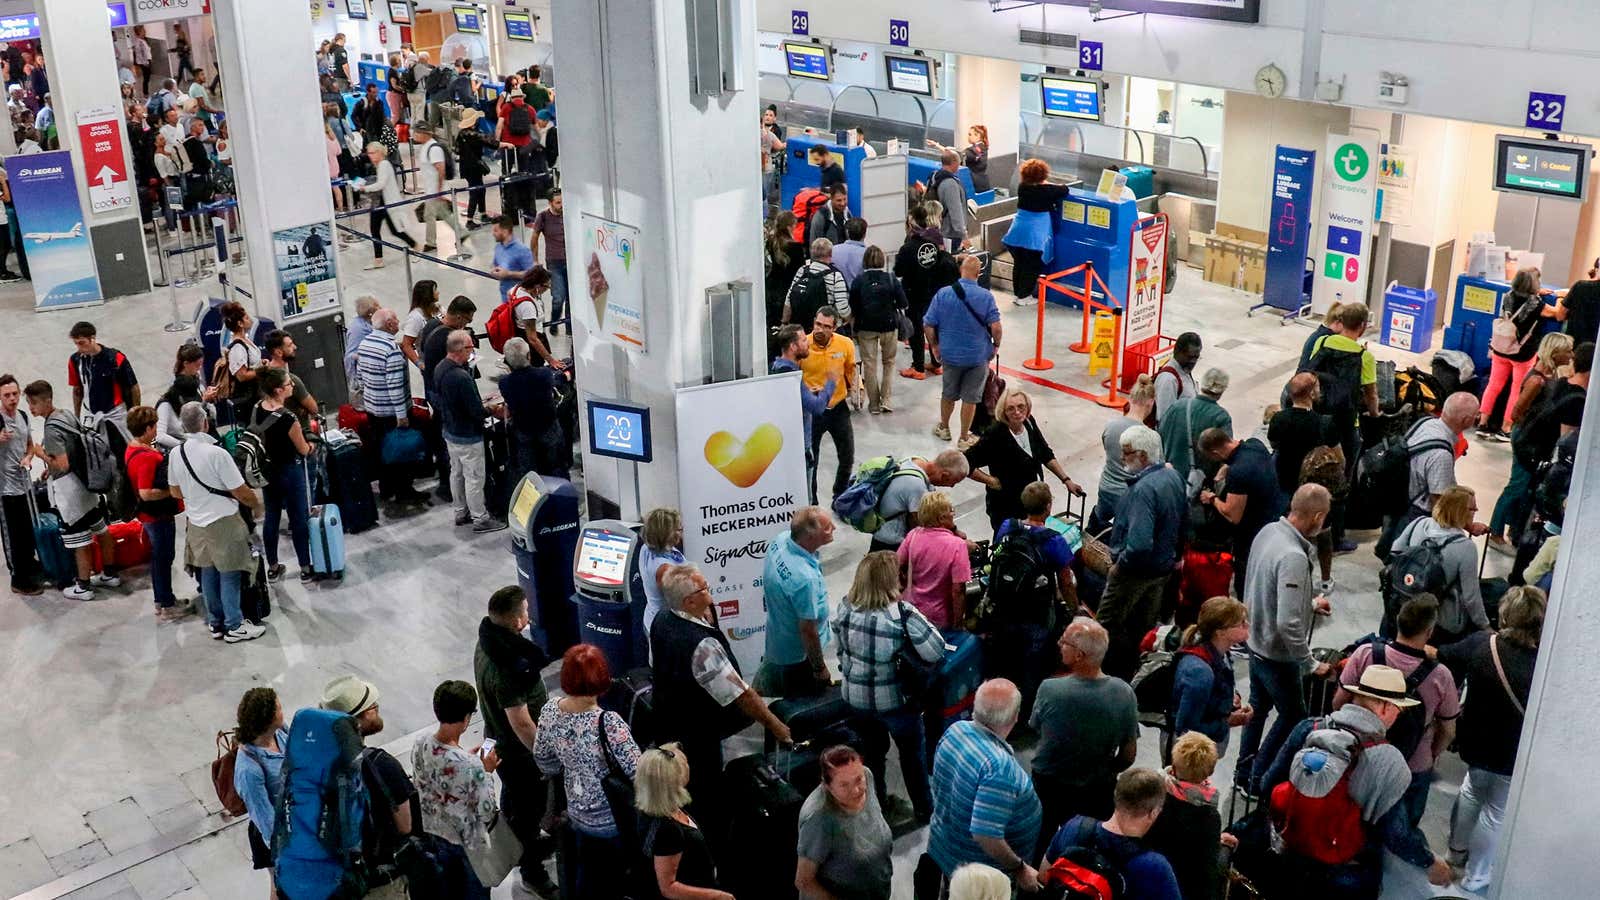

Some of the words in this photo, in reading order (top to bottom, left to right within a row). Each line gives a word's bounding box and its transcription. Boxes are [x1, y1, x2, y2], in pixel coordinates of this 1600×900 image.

[792, 15, 808, 30] 29
[890, 25, 908, 41] 30
[1081, 46, 1101, 65] 31
[1529, 99, 1562, 123] 32
[33, 166, 62, 176] AEGEAN
[1331, 182, 1368, 195] transavia
[1328, 211, 1364, 226] Welcome
[700, 500, 756, 520] Thomas
[758, 492, 794, 510] Cook
[552, 522, 577, 534] AEGEAN
[704, 540, 769, 568] Signatu
[596, 626, 623, 637] AEGEAN
